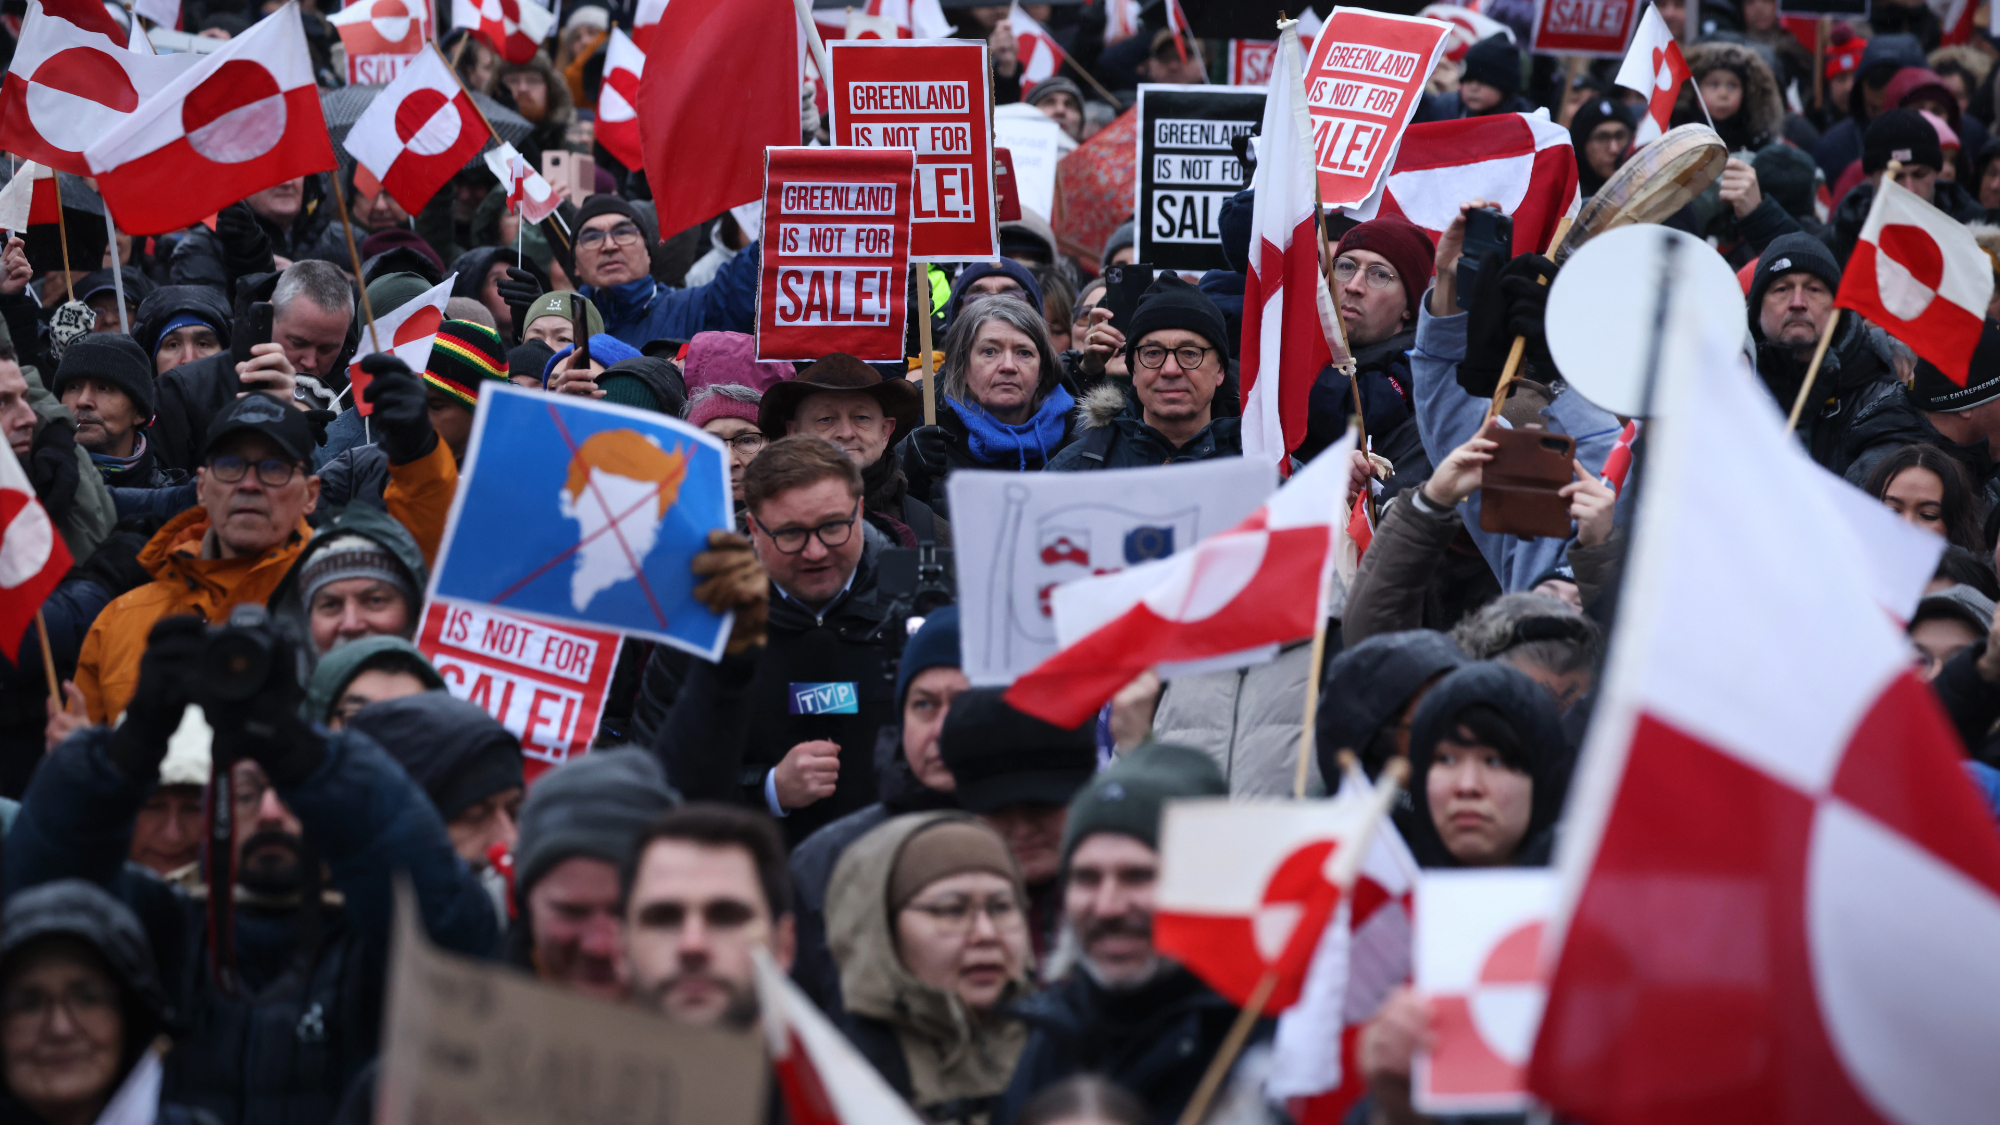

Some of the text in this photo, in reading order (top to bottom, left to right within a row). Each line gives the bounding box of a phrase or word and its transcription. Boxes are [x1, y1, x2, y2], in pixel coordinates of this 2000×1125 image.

[1552, 0, 1624, 31] SALE!
[1327, 46, 1415, 78] GREENLAND
[853, 85, 966, 110] GREENLAND
[1309, 81, 1398, 114] IS NOT FOR
[854, 127, 967, 151] IS NOT FOR
[1311, 119, 1382, 173] ALE!
[1157, 159, 1244, 181] IS NOT FO
[784, 185, 893, 211] GREENLAND
[913, 167, 972, 219] LE!
[1156, 195, 1232, 238] SAL
[781, 227, 890, 253] IS NOT FOR
[778, 270, 889, 322] SALE!
[447, 608, 590, 675] IS NOT FOR
[800, 685, 850, 712] TVP
